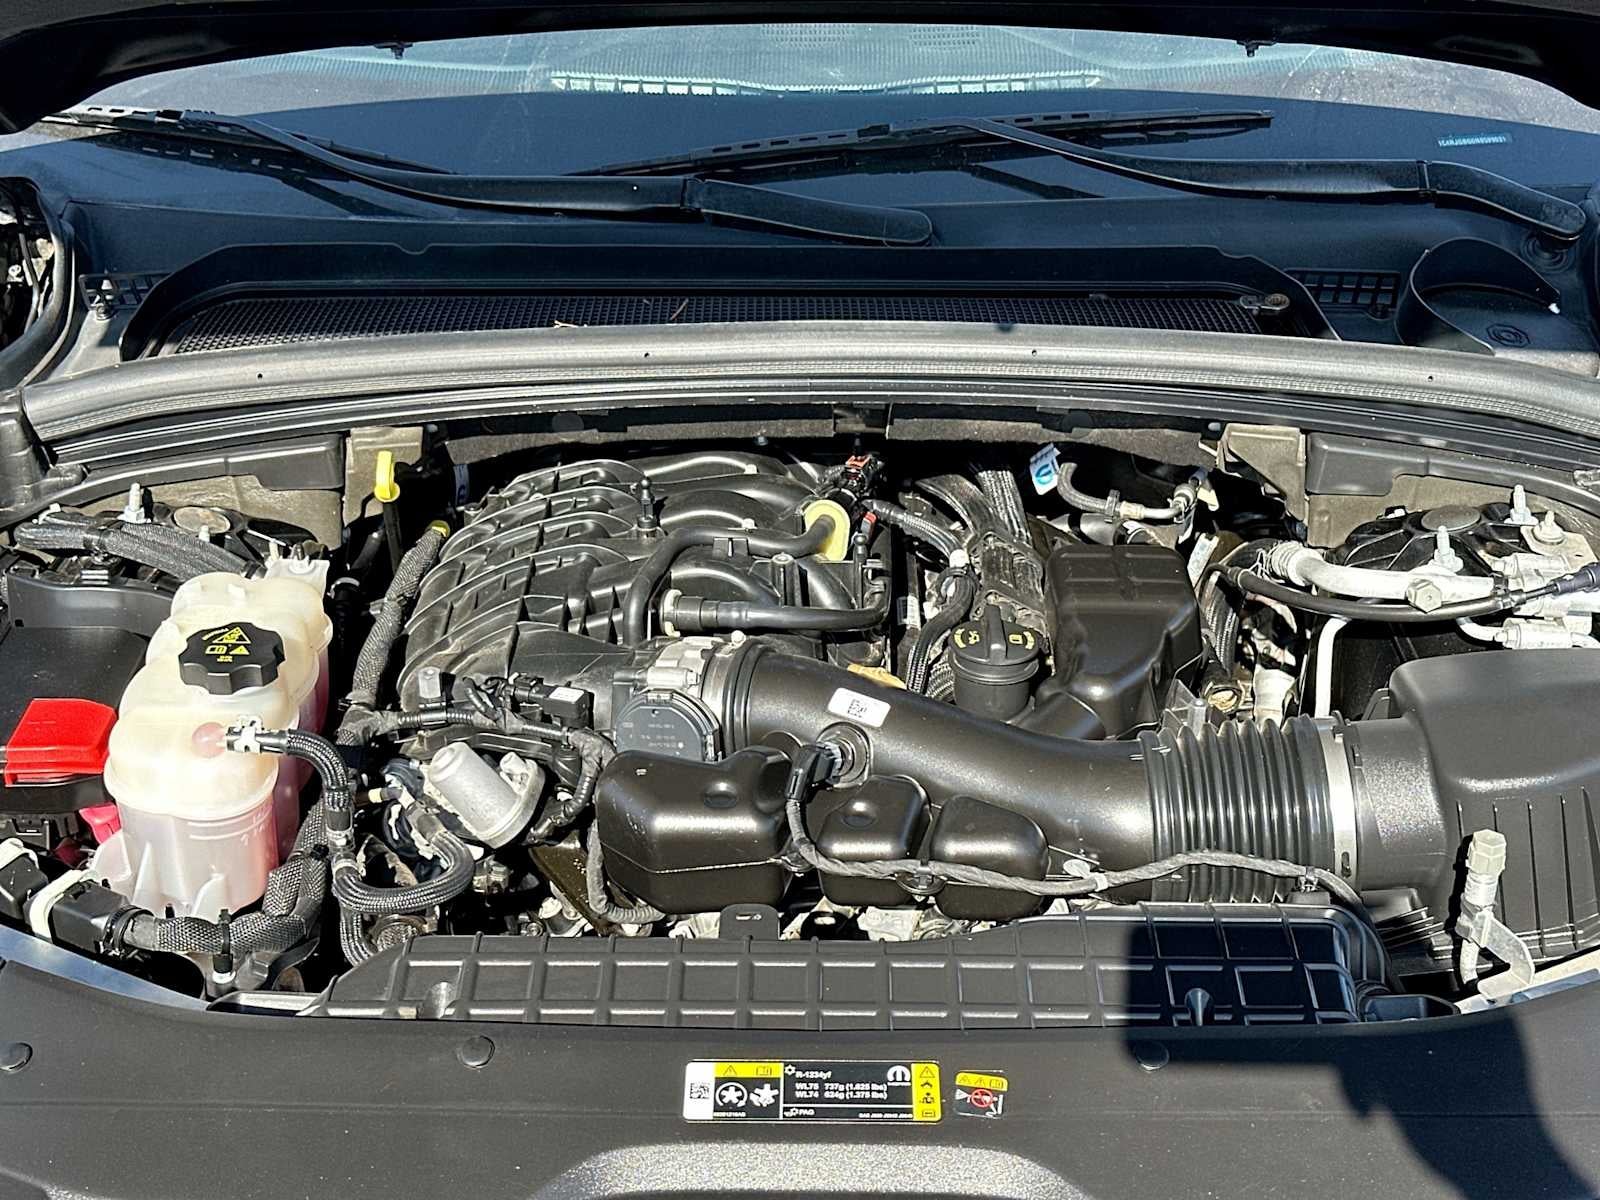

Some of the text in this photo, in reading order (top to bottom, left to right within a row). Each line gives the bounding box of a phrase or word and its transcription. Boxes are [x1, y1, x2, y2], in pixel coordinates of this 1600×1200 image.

[795, 1070, 832, 1080] R-1234yf
[795, 1082, 819, 1090] WL75
[824, 1082, 845, 1092] 737g
[871, 1082, 888, 1092] lbs)
[845, 1091, 870, 1100] (1.375
[871, 1091, 888, 1100] lbs)
